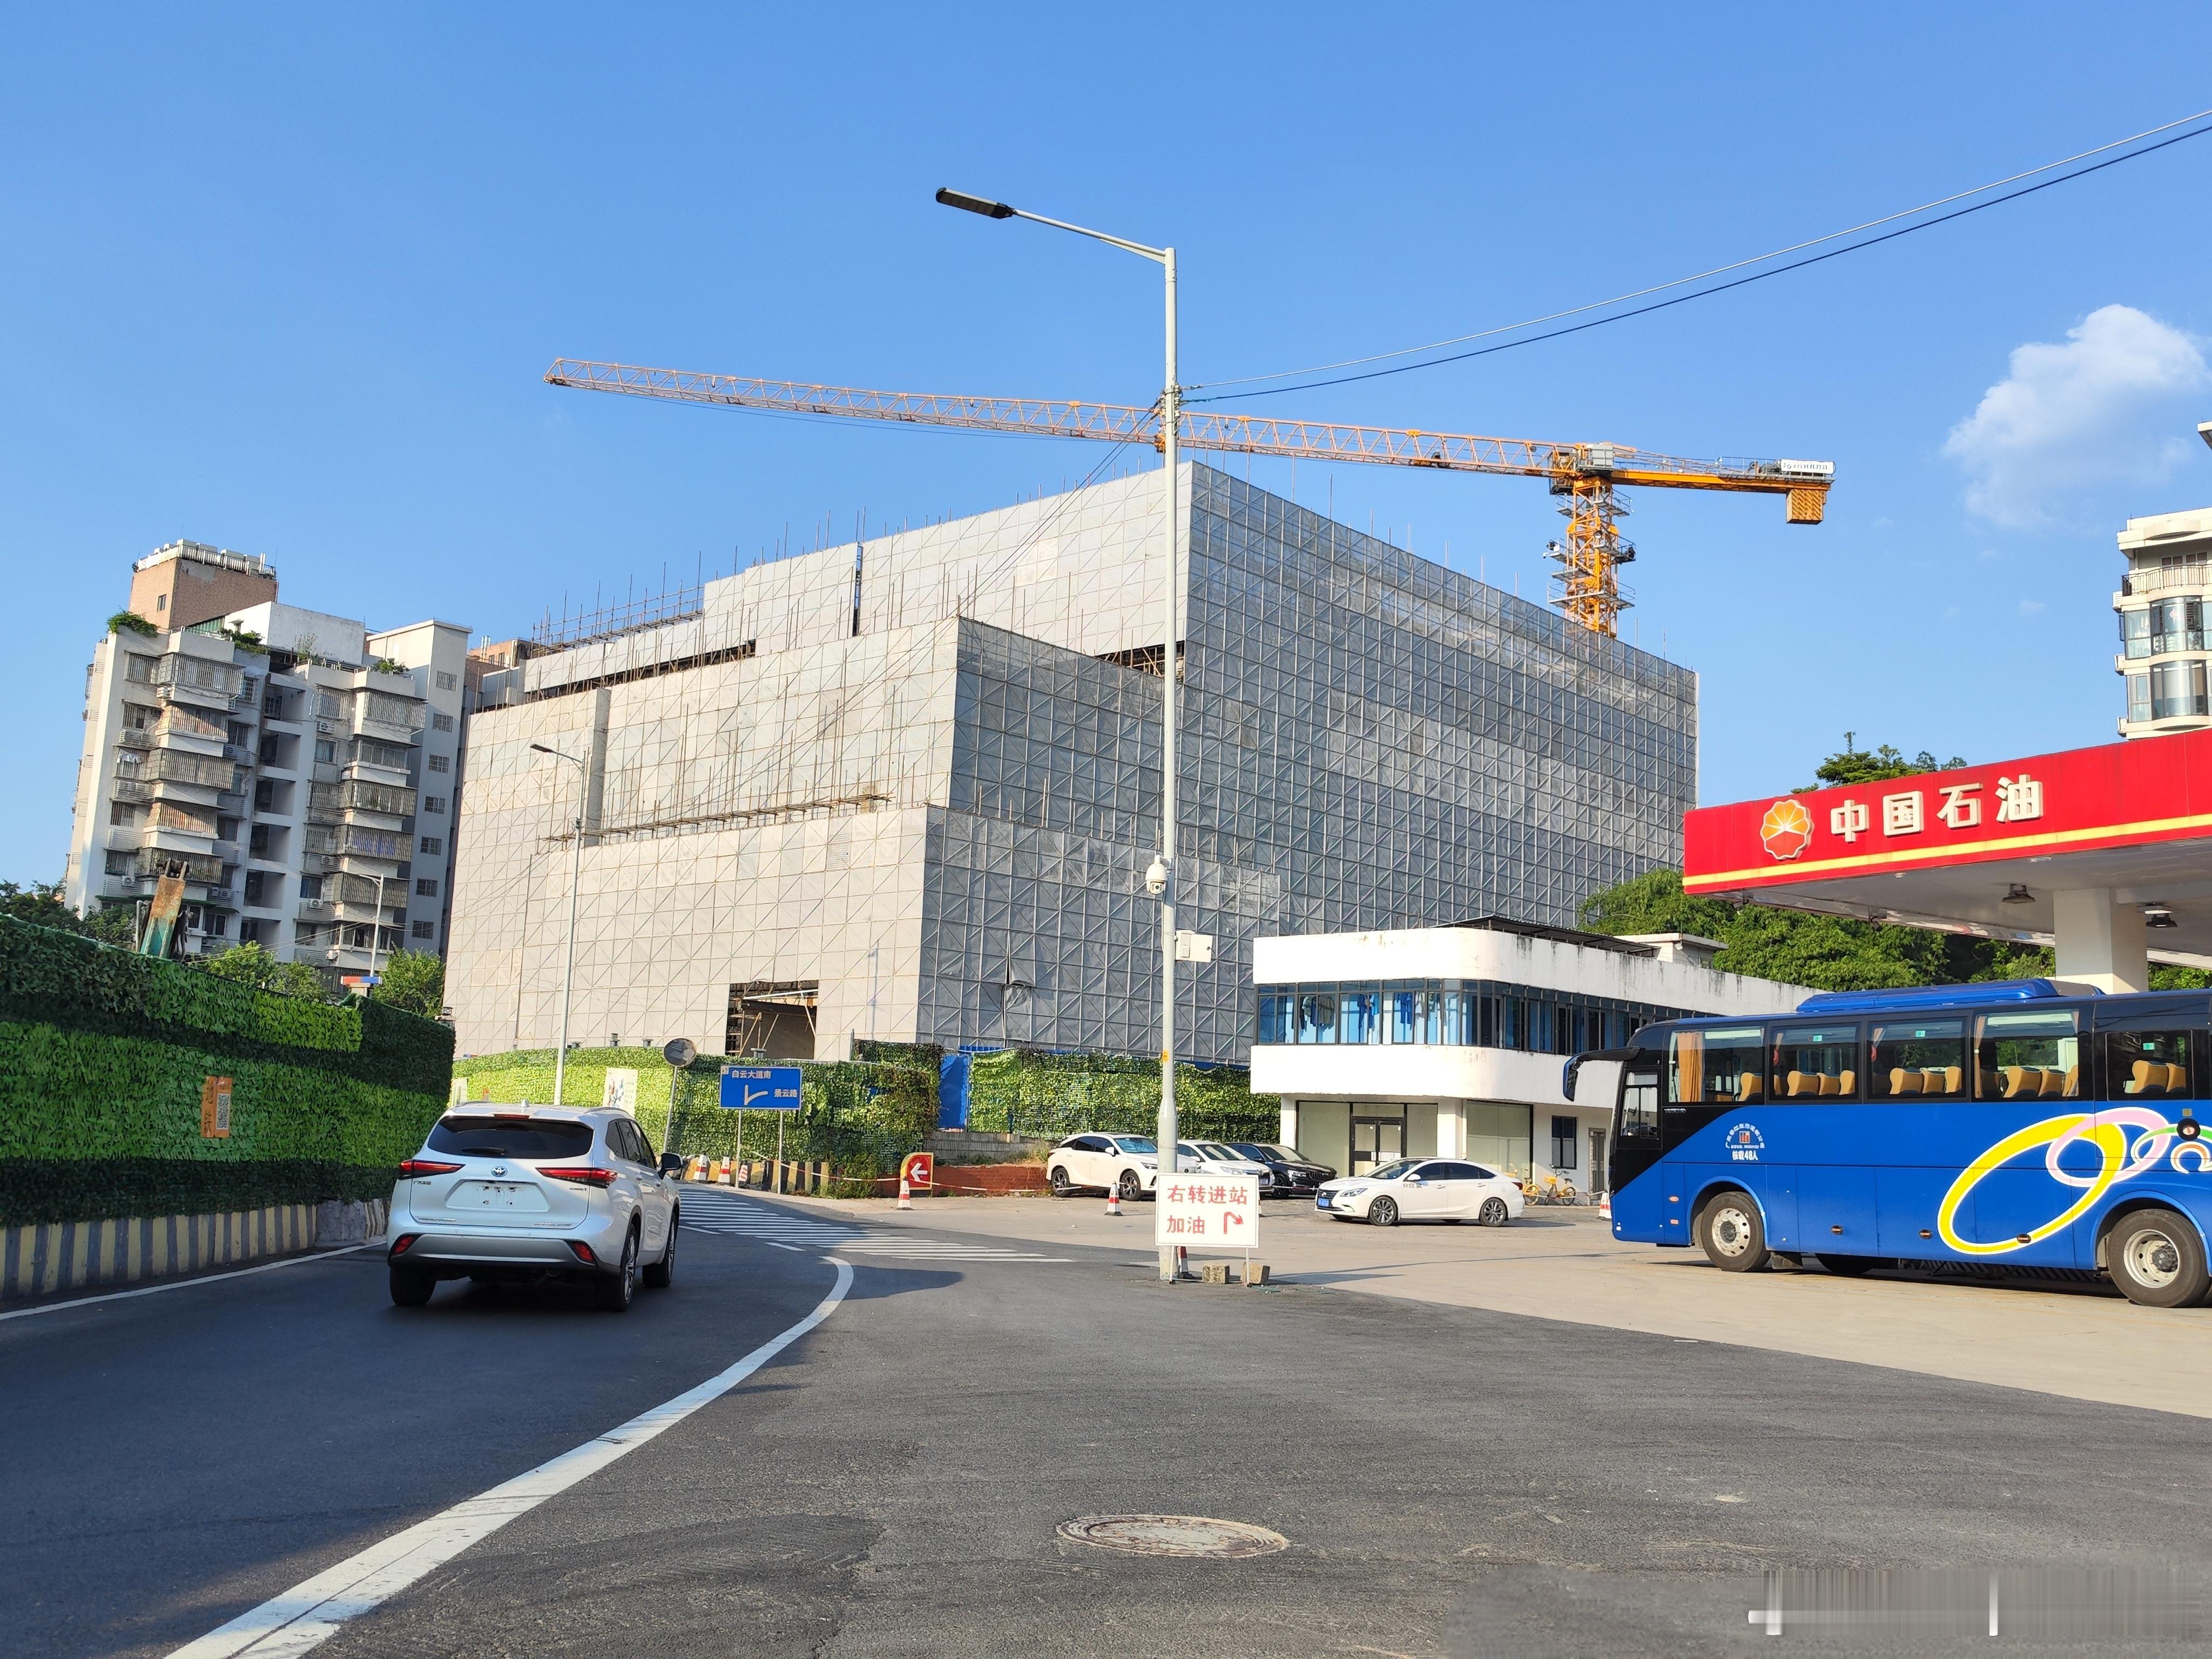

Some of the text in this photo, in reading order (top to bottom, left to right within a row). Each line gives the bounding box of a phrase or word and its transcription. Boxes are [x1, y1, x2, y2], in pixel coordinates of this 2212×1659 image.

[1830, 774, 2044, 843] 中国石油
[732, 1070, 772, 1079] 白云大道南
[1167, 1185, 1247, 1205] 右转进站
[1166, 1215, 1205, 1235] 加油
